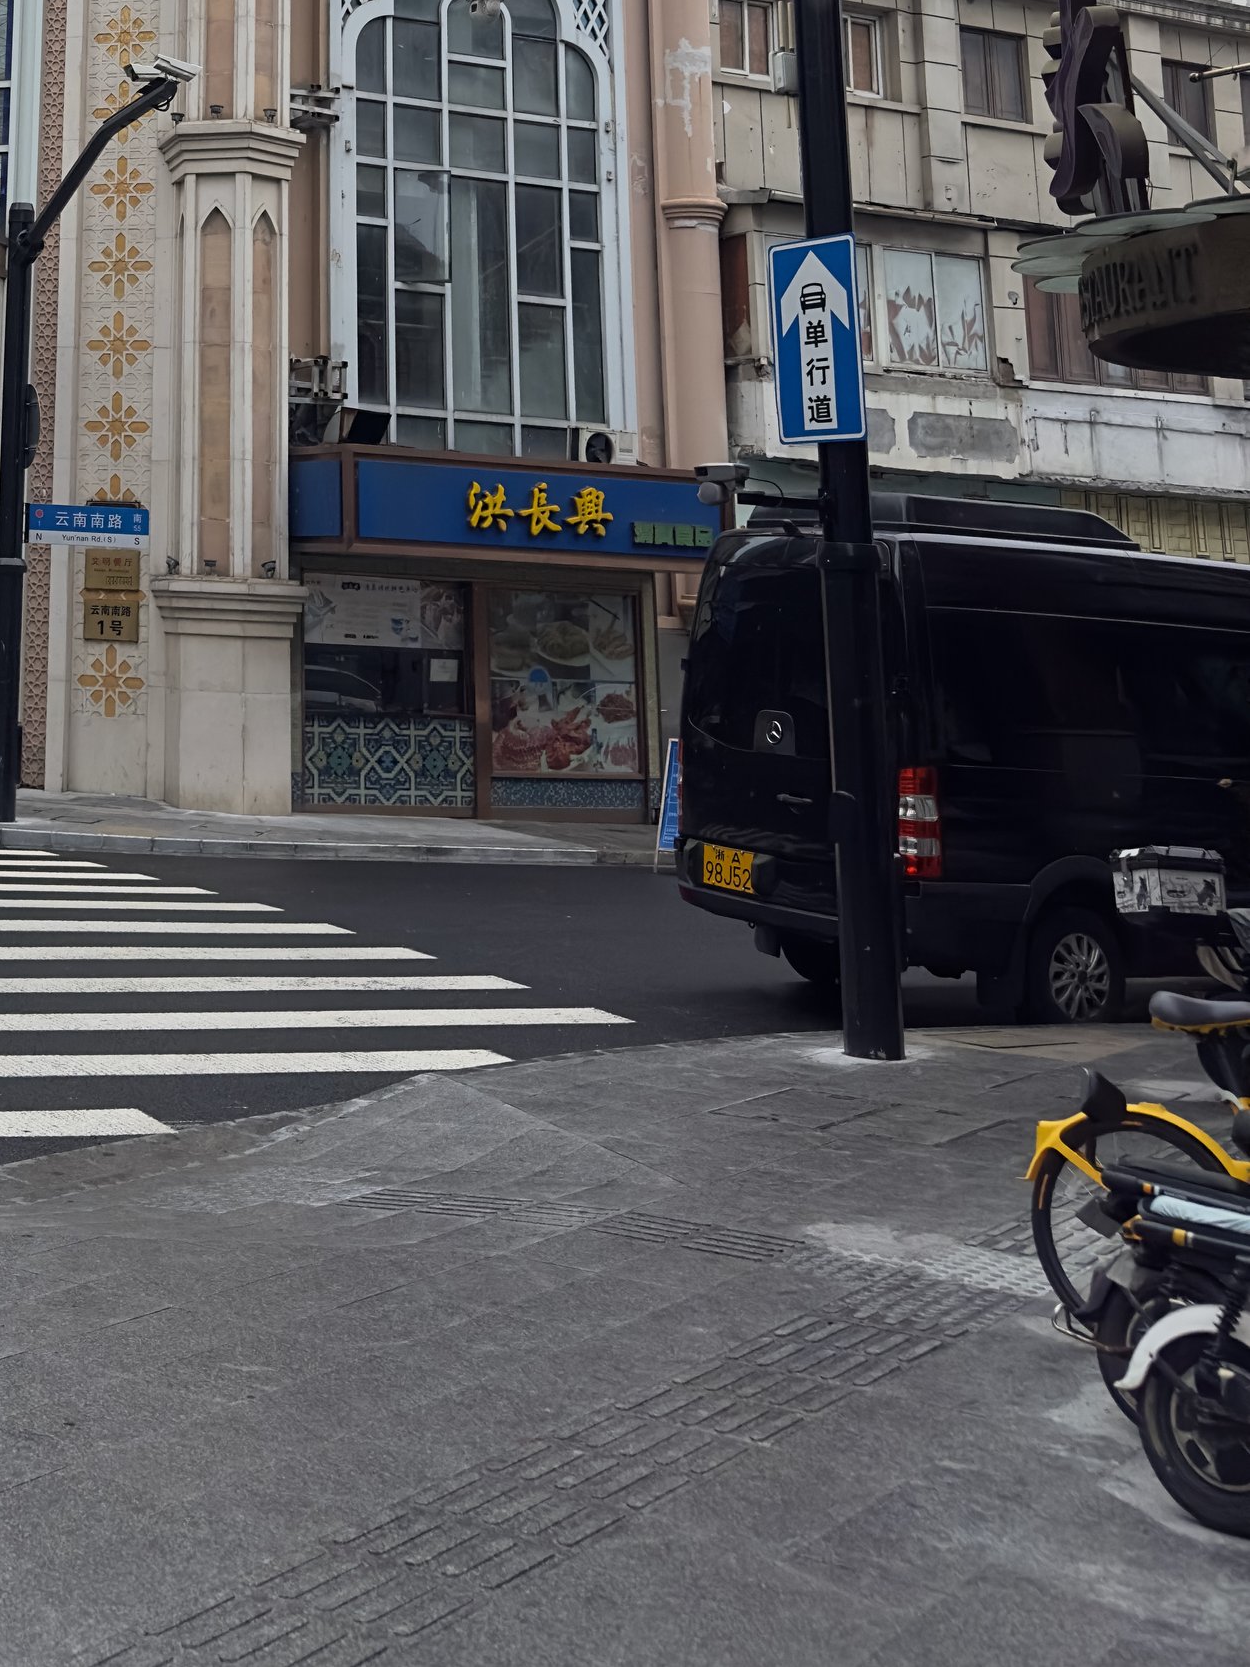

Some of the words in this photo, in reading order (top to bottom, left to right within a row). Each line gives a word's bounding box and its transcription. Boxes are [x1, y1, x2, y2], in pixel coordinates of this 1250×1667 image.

[804, 319, 833, 424] 单行道
[468, 481, 614, 536] 洪長興
[55, 511, 123, 529] 云南南路
[133, 514, 142, 524] 南
[35, 533, 43, 541] N
[134, 537, 140, 545] S
[90, 605, 132, 617] 云南南路
[97, 619, 123, 636] 1号
[705, 860, 751, 891] 98J52
